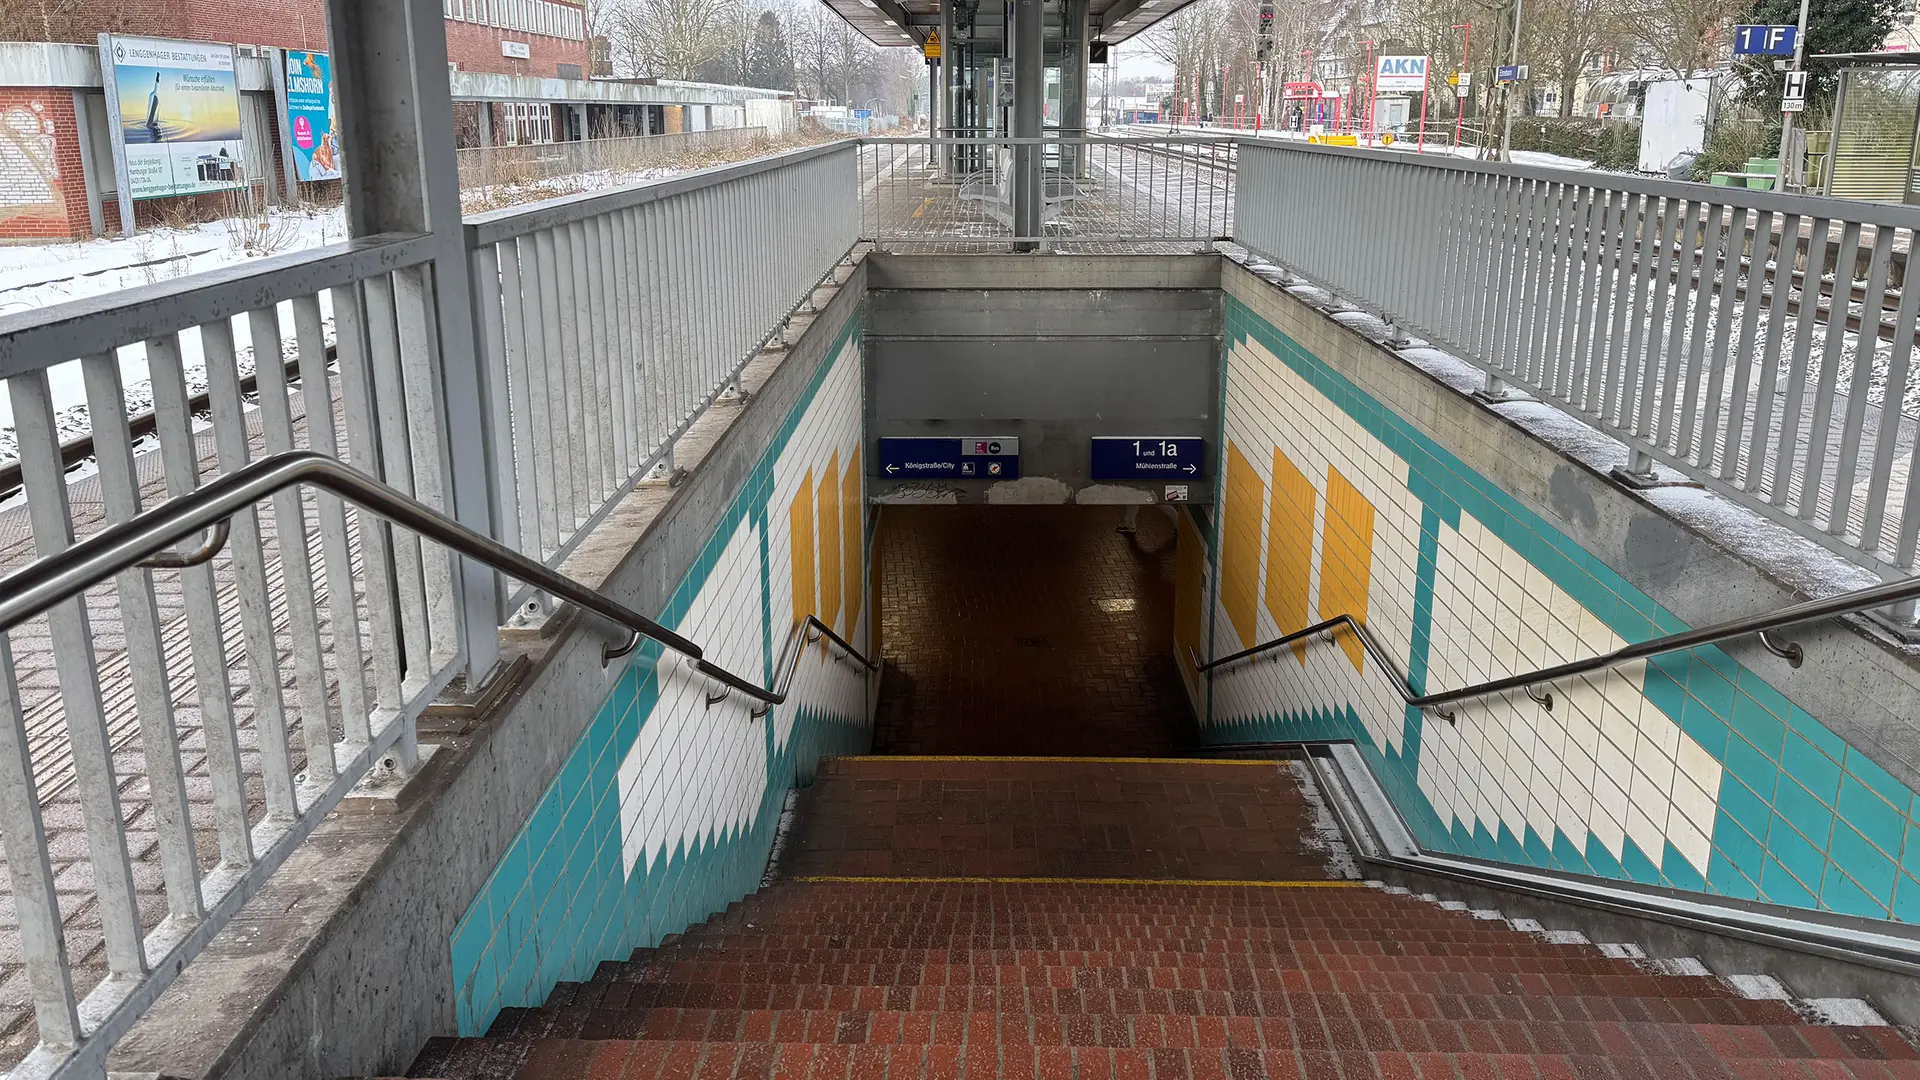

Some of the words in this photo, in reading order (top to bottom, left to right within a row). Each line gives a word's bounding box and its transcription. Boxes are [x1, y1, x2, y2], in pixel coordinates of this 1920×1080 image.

[1741, 28, 1751, 49] 1
[1770, 28, 1786, 50] F
[129, 49, 170, 60] LENGGENHAGER
[171, 52, 207, 62] BESTATTUNGEN
[1380, 59, 1425, 74] AKN
[1786, 74, 1804, 97] H
[1133, 441, 1141, 456] 1
[1158, 441, 1178, 456] 1a
[904, 462, 955, 470] Königstraße/City
[1135, 462, 1178, 470] Mühlenstraße
